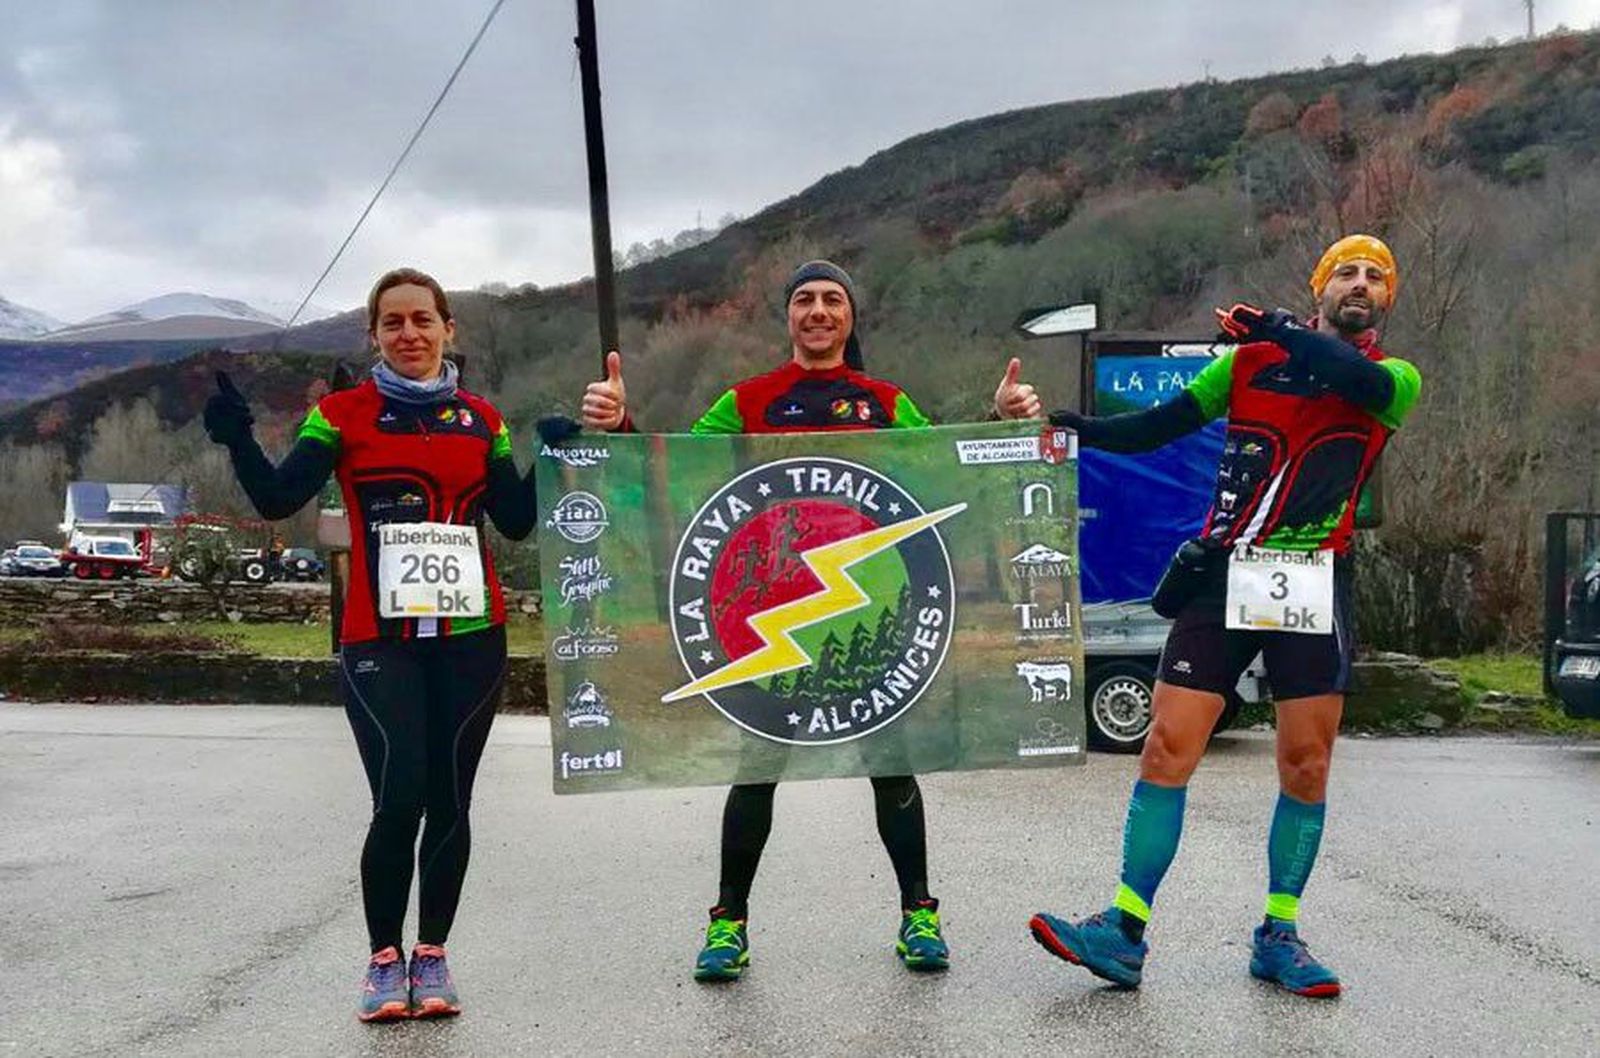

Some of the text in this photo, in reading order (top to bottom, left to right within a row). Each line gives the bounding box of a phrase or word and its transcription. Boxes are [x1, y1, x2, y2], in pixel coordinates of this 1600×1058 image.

[1113, 371, 1143, 392] LA
[962, 439, 1034, 452] AYUNTAMIENTO
[966, 453, 979, 461] DE
[383, 528, 473, 547] Liberbank
[679, 467, 882, 643] LA RAYA TRAIL
[1234, 546, 1326, 567] Liberbank
[400, 553, 461, 585] 266
[1269, 571, 1290, 601] 3
[807, 606, 944, 734] ALCAÑICES
